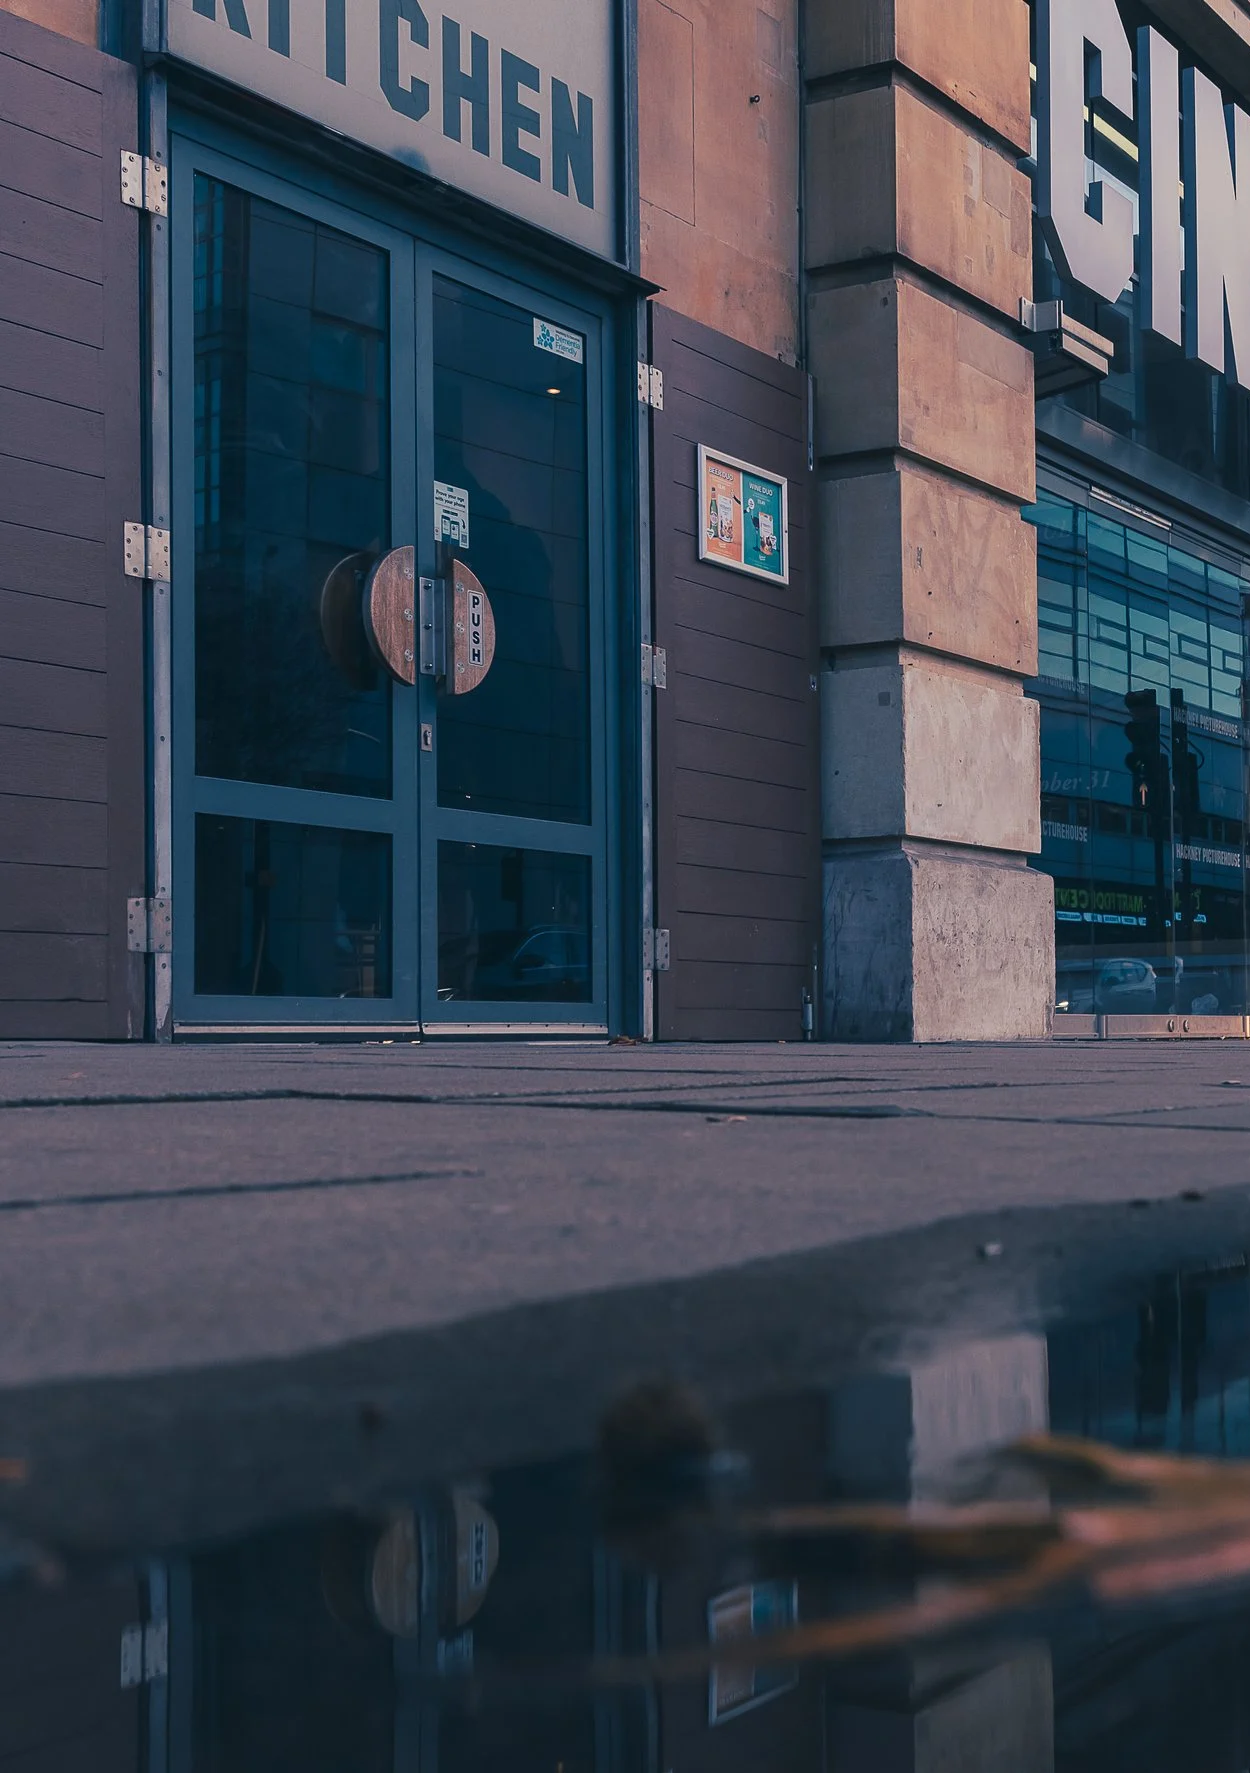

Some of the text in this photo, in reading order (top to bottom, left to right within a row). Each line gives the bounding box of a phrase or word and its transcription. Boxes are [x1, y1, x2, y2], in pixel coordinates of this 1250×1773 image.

[192, 0, 595, 209] CHEN
[762, 486, 773, 496] DUO
[472, 595, 481, 662] PUSH
[1173, 706, 1238, 740] HACKNEY PICTUREHOUSE
[1042, 820, 1088, 842] CTUREHOUSE
[1175, 843, 1241, 868] HACKNEY PICTUREHOUSE
